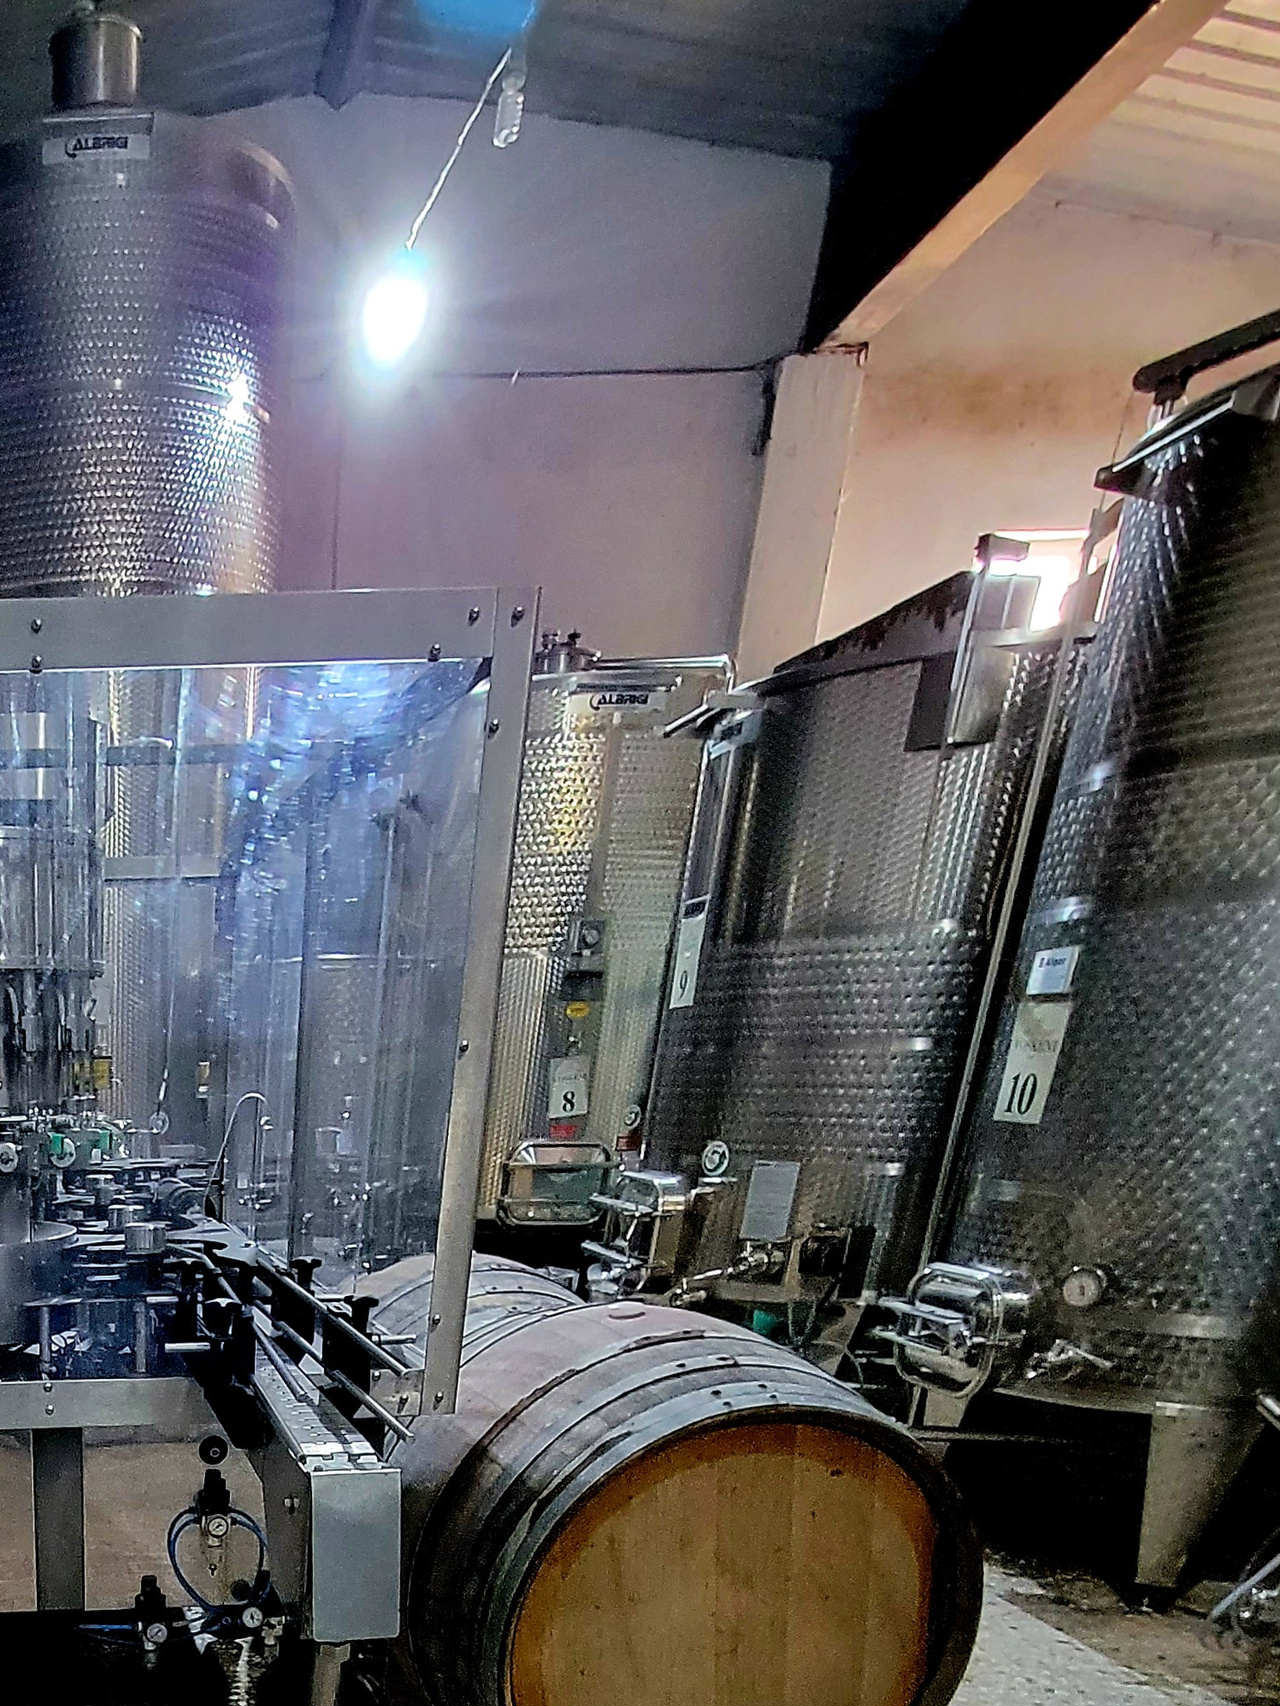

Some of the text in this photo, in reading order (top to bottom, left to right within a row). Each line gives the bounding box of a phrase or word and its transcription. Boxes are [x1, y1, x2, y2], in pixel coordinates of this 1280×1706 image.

[679, 970, 689, 1000] 9
[562, 1090, 576, 1113] 8
[1003, 1071, 1038, 1115] 10
